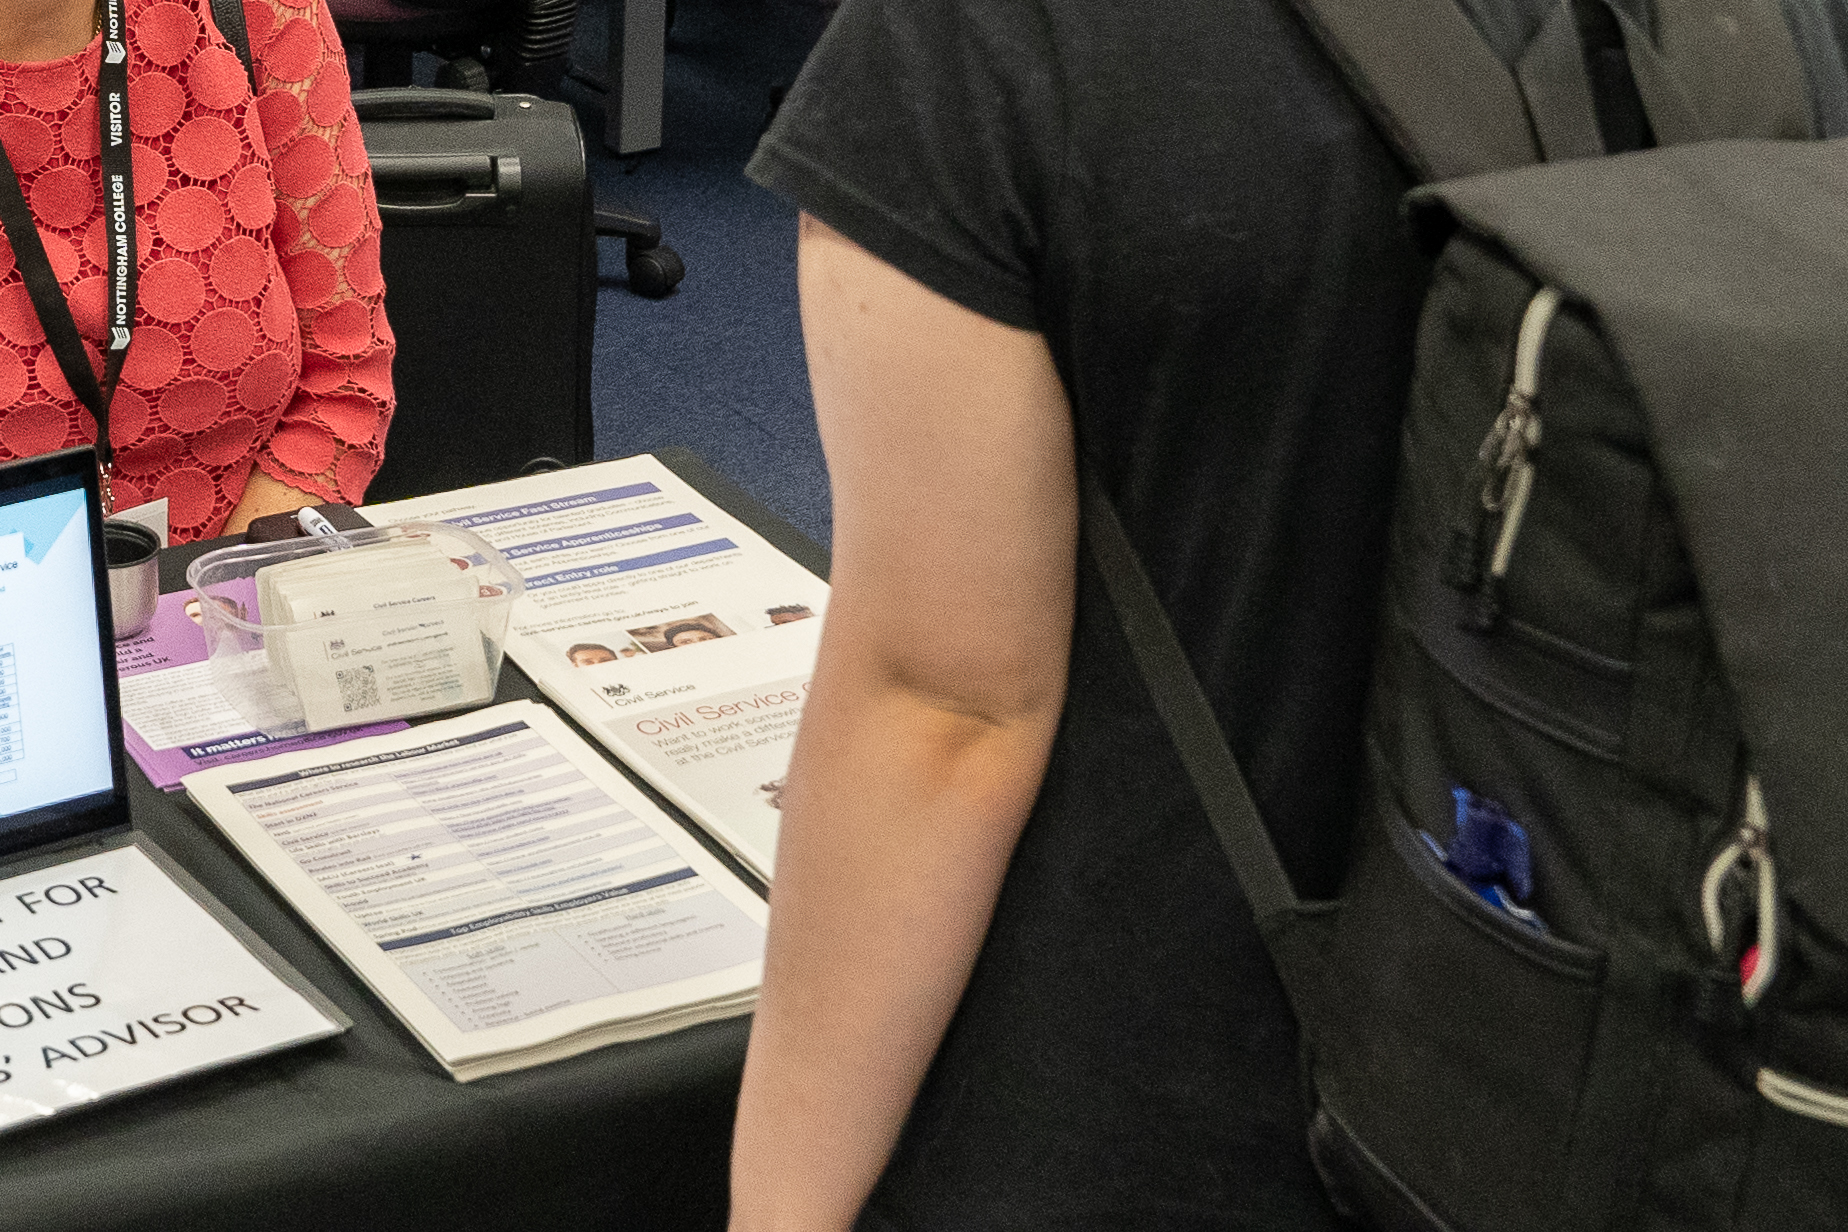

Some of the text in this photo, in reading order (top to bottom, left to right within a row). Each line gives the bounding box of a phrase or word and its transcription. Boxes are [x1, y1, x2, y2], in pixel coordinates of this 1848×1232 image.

[110, 92, 122, 147] VISITOR
[111, 174, 129, 326] NOTTINGHAM COLLEGE
[473, 509, 520, 525] Service
[521, 503, 550, 516] Fast
[551, 495, 597, 511] Stream
[512, 522, 663, 558] Service Apprenticeships
[133, 636, 155, 646] and
[331, 644, 383, 661] Civil Service
[132, 652, 155, 662] and
[614, 682, 696, 707] Civil Service
[636, 689, 800, 736] Civil Service
[190, 747, 205, 758] It
[205, 734, 266, 754] matters
[651, 731, 690, 749] Want
[691, 727, 707, 738] to
[708, 720, 741, 734] work
[691, 751, 714, 763] the
[715, 742, 746, 756] Civil
[19, 875, 118, 916] FOR
[40, 994, 261, 1069] ADVISOR
